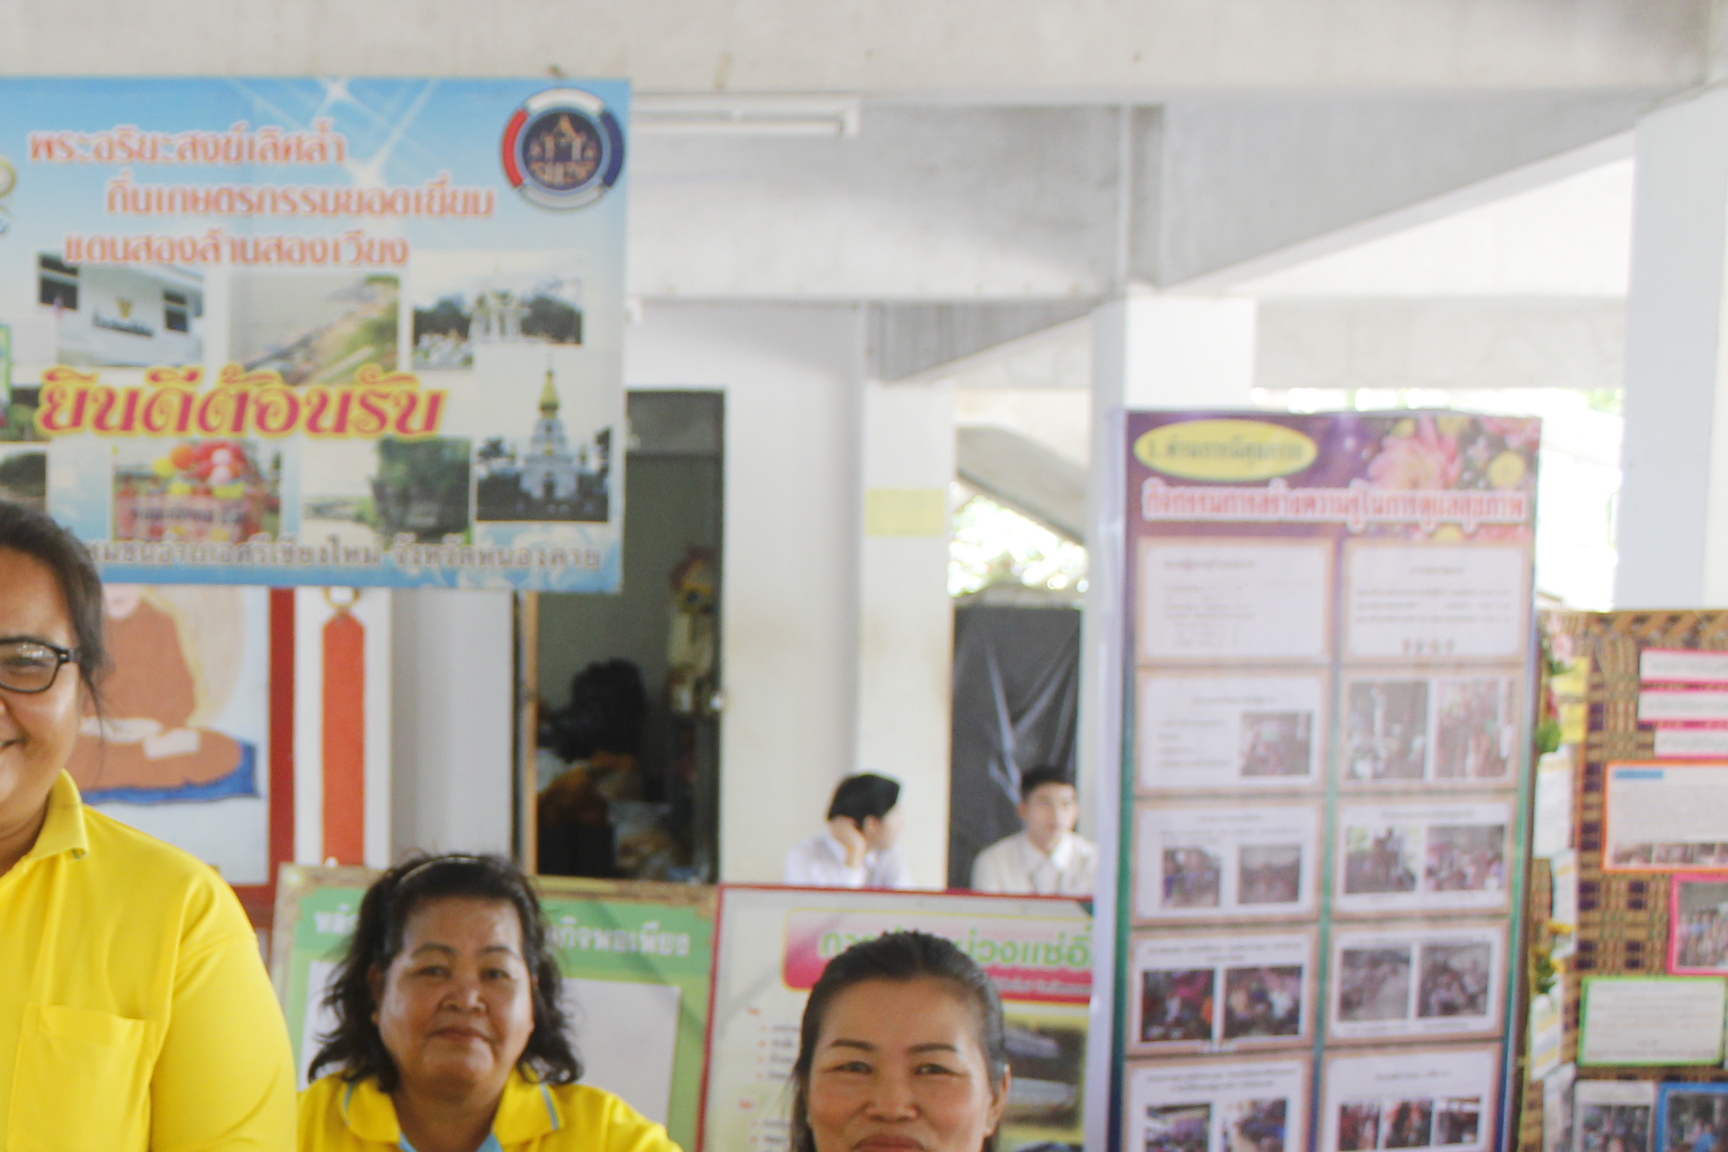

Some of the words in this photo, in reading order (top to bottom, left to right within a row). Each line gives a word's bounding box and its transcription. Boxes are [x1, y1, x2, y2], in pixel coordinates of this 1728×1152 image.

[37, 363, 449, 437] ยินดีต้อนรับ
